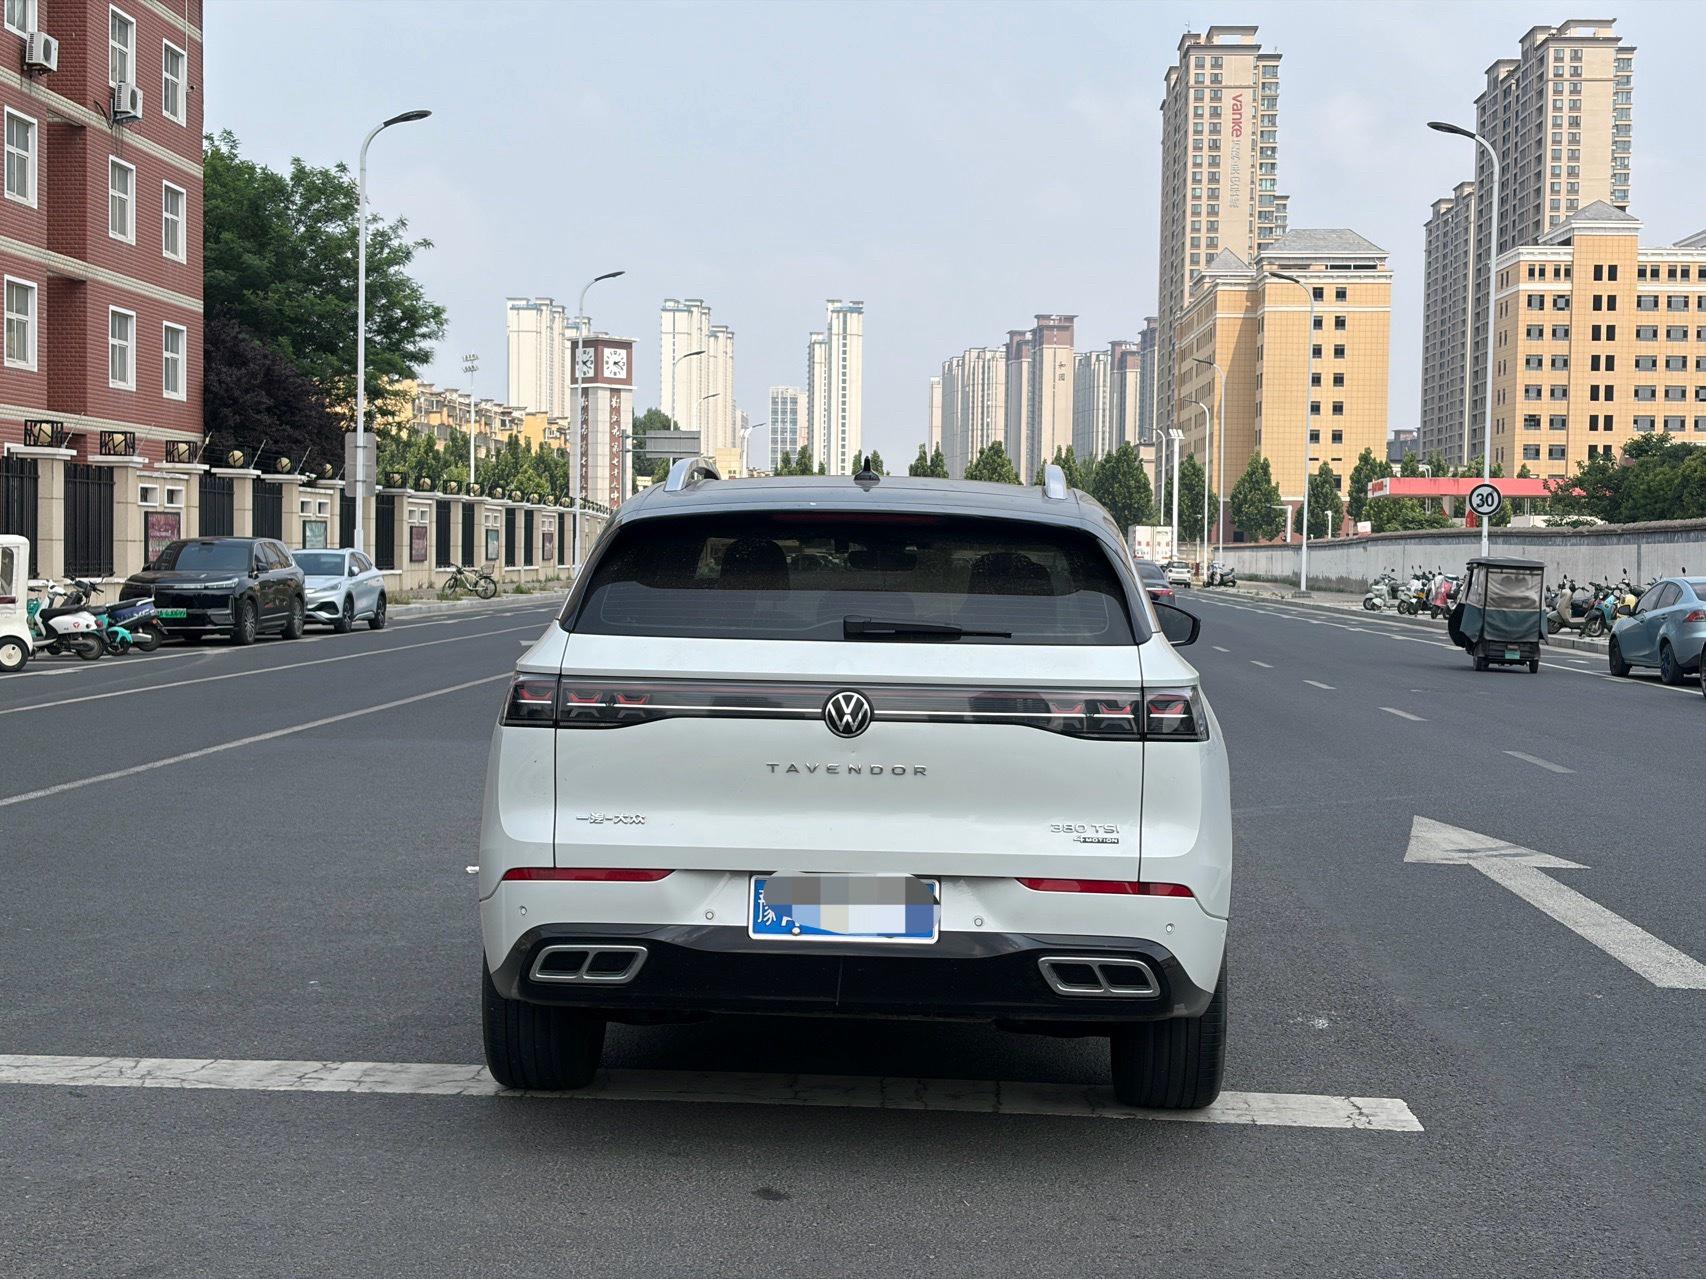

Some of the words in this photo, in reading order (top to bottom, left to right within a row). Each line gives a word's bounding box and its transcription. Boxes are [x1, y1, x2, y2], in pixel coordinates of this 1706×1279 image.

[1475, 492, 1495, 508] 30
[765, 762, 928, 777] TAVENDOR
[1050, 823, 1087, 834] 380
[1090, 823, 1120, 834] TSI
